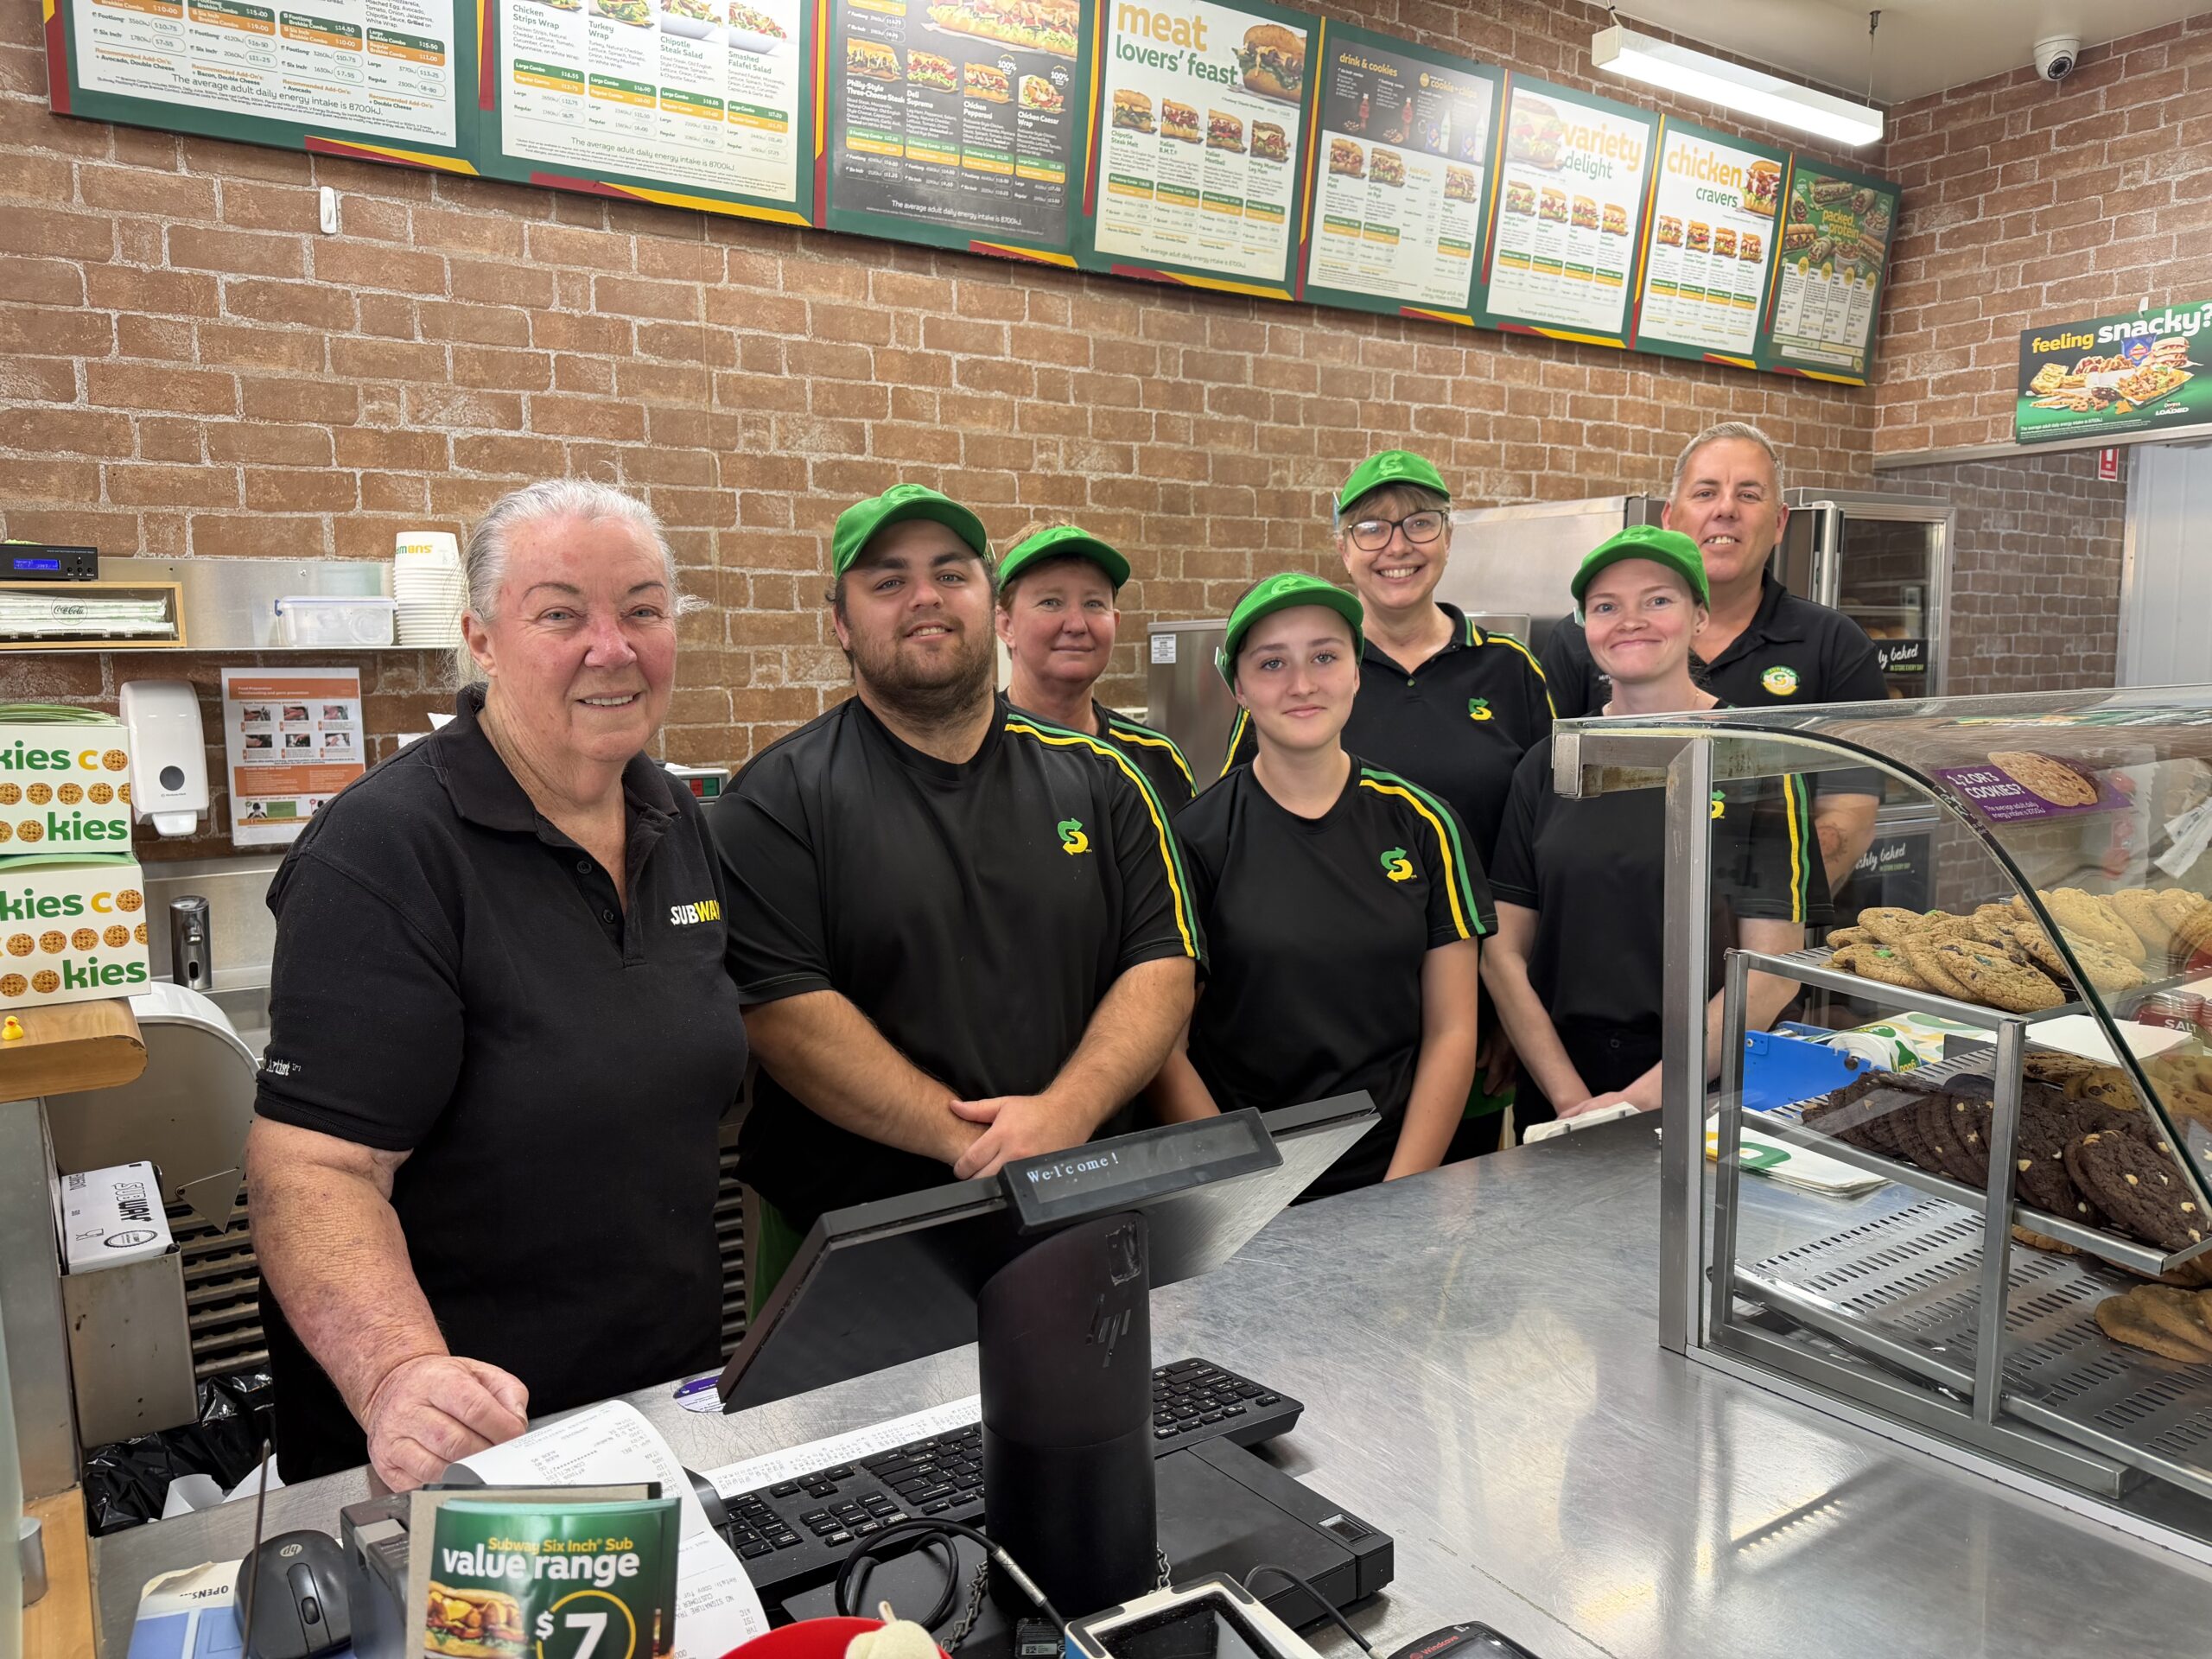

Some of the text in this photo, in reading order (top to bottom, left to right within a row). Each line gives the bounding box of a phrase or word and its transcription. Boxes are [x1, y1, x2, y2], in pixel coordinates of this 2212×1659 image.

[98, 12, 125, 23] Footlong
[512, 4, 544, 18] Chicken
[512, 13, 561, 30] Strips Wrap
[588, 20, 614, 34] Turkey
[1117, 2, 1209, 53] meat
[194, 29, 221, 41] Footlong
[588, 29, 610, 41] Wrap
[660, 35, 691, 49] Chipotle
[285, 46, 311, 56] Footlong
[660, 44, 683, 56] Steak
[683, 48, 704, 60] Salad
[728, 50, 760, 64] Smashed
[130, 58, 152, 69] Double
[153, 62, 175, 73] Cheese
[287, 60, 296, 69] Six
[367, 60, 382, 68] Large
[728, 59, 752, 70] Falafel
[753, 63, 772, 75] Salad
[997, 60, 1017, 72] 100%
[1115, 34, 1239, 86] lovers' feast
[1339, 52, 1398, 78] drink & cookies
[218, 73, 239, 84] Double
[239, 77, 261, 86] Cheese
[367, 74, 388, 85] Regular
[1051, 71, 1070, 83] 100%
[171, 73, 191, 85] The
[192, 79, 230, 92] average
[230, 84, 255, 96] adult
[255, 87, 278, 102] daily
[278, 92, 311, 107] energy
[311, 95, 340, 110] intake
[340, 99, 347, 111] is
[887, 93, 906, 104] Steak
[907, 90, 920, 99] Deli
[372, 99, 413, 111] Double Cheese
[906, 99, 934, 109] Supreme
[963, 100, 988, 111] Chicken
[1017, 111, 1059, 125] Chicken Caesar
[1017, 118, 1034, 129] Wrap
[570, 137, 585, 146] The
[586, 141, 615, 154] average
[615, 144, 635, 156] adult
[635, 148, 653, 161] daily
[653, 152, 679, 165] energy
[679, 155, 701, 167] intake
[702, 158, 709, 167] is
[1561, 123, 1642, 173] variety
[1564, 149, 1613, 181] delight
[1667, 143, 1743, 188] chicken
[1695, 187, 1738, 208] cravers
[892, 200, 904, 209] The
[904, 202, 926, 213] average
[927, 206, 942, 215] adult
[942, 208, 957, 218] daily
[957, 212, 977, 221] energy
[977, 213, 995, 222] intake
[1822, 207, 1855, 226] packed
[1827, 221, 1860, 240] protein
[2031, 302, 2212, 354] feeling snacky?
[2155, 406, 2190, 416] LOADED
[1890, 643, 1919, 662] baked
[1964, 783, 2025, 799] COOKIES?
[48, 810, 129, 842] kies
[1880, 842, 1906, 862] baked
[0, 887, 84, 922] kies
[62, 956, 147, 991] kies
[1027, 1151, 1120, 1185] Welcome!
[111, 1181, 154, 1223] SUBWAY
[488, 1537, 540, 1555] Subway
[543, 1540, 566, 1553] Six
[606, 1537, 634, 1551] Sub
[442, 1543, 640, 1589] value range
[683, 1592, 714, 1607] CUSTOMER
[690, 1598, 724, 1615] SIGNATURE
